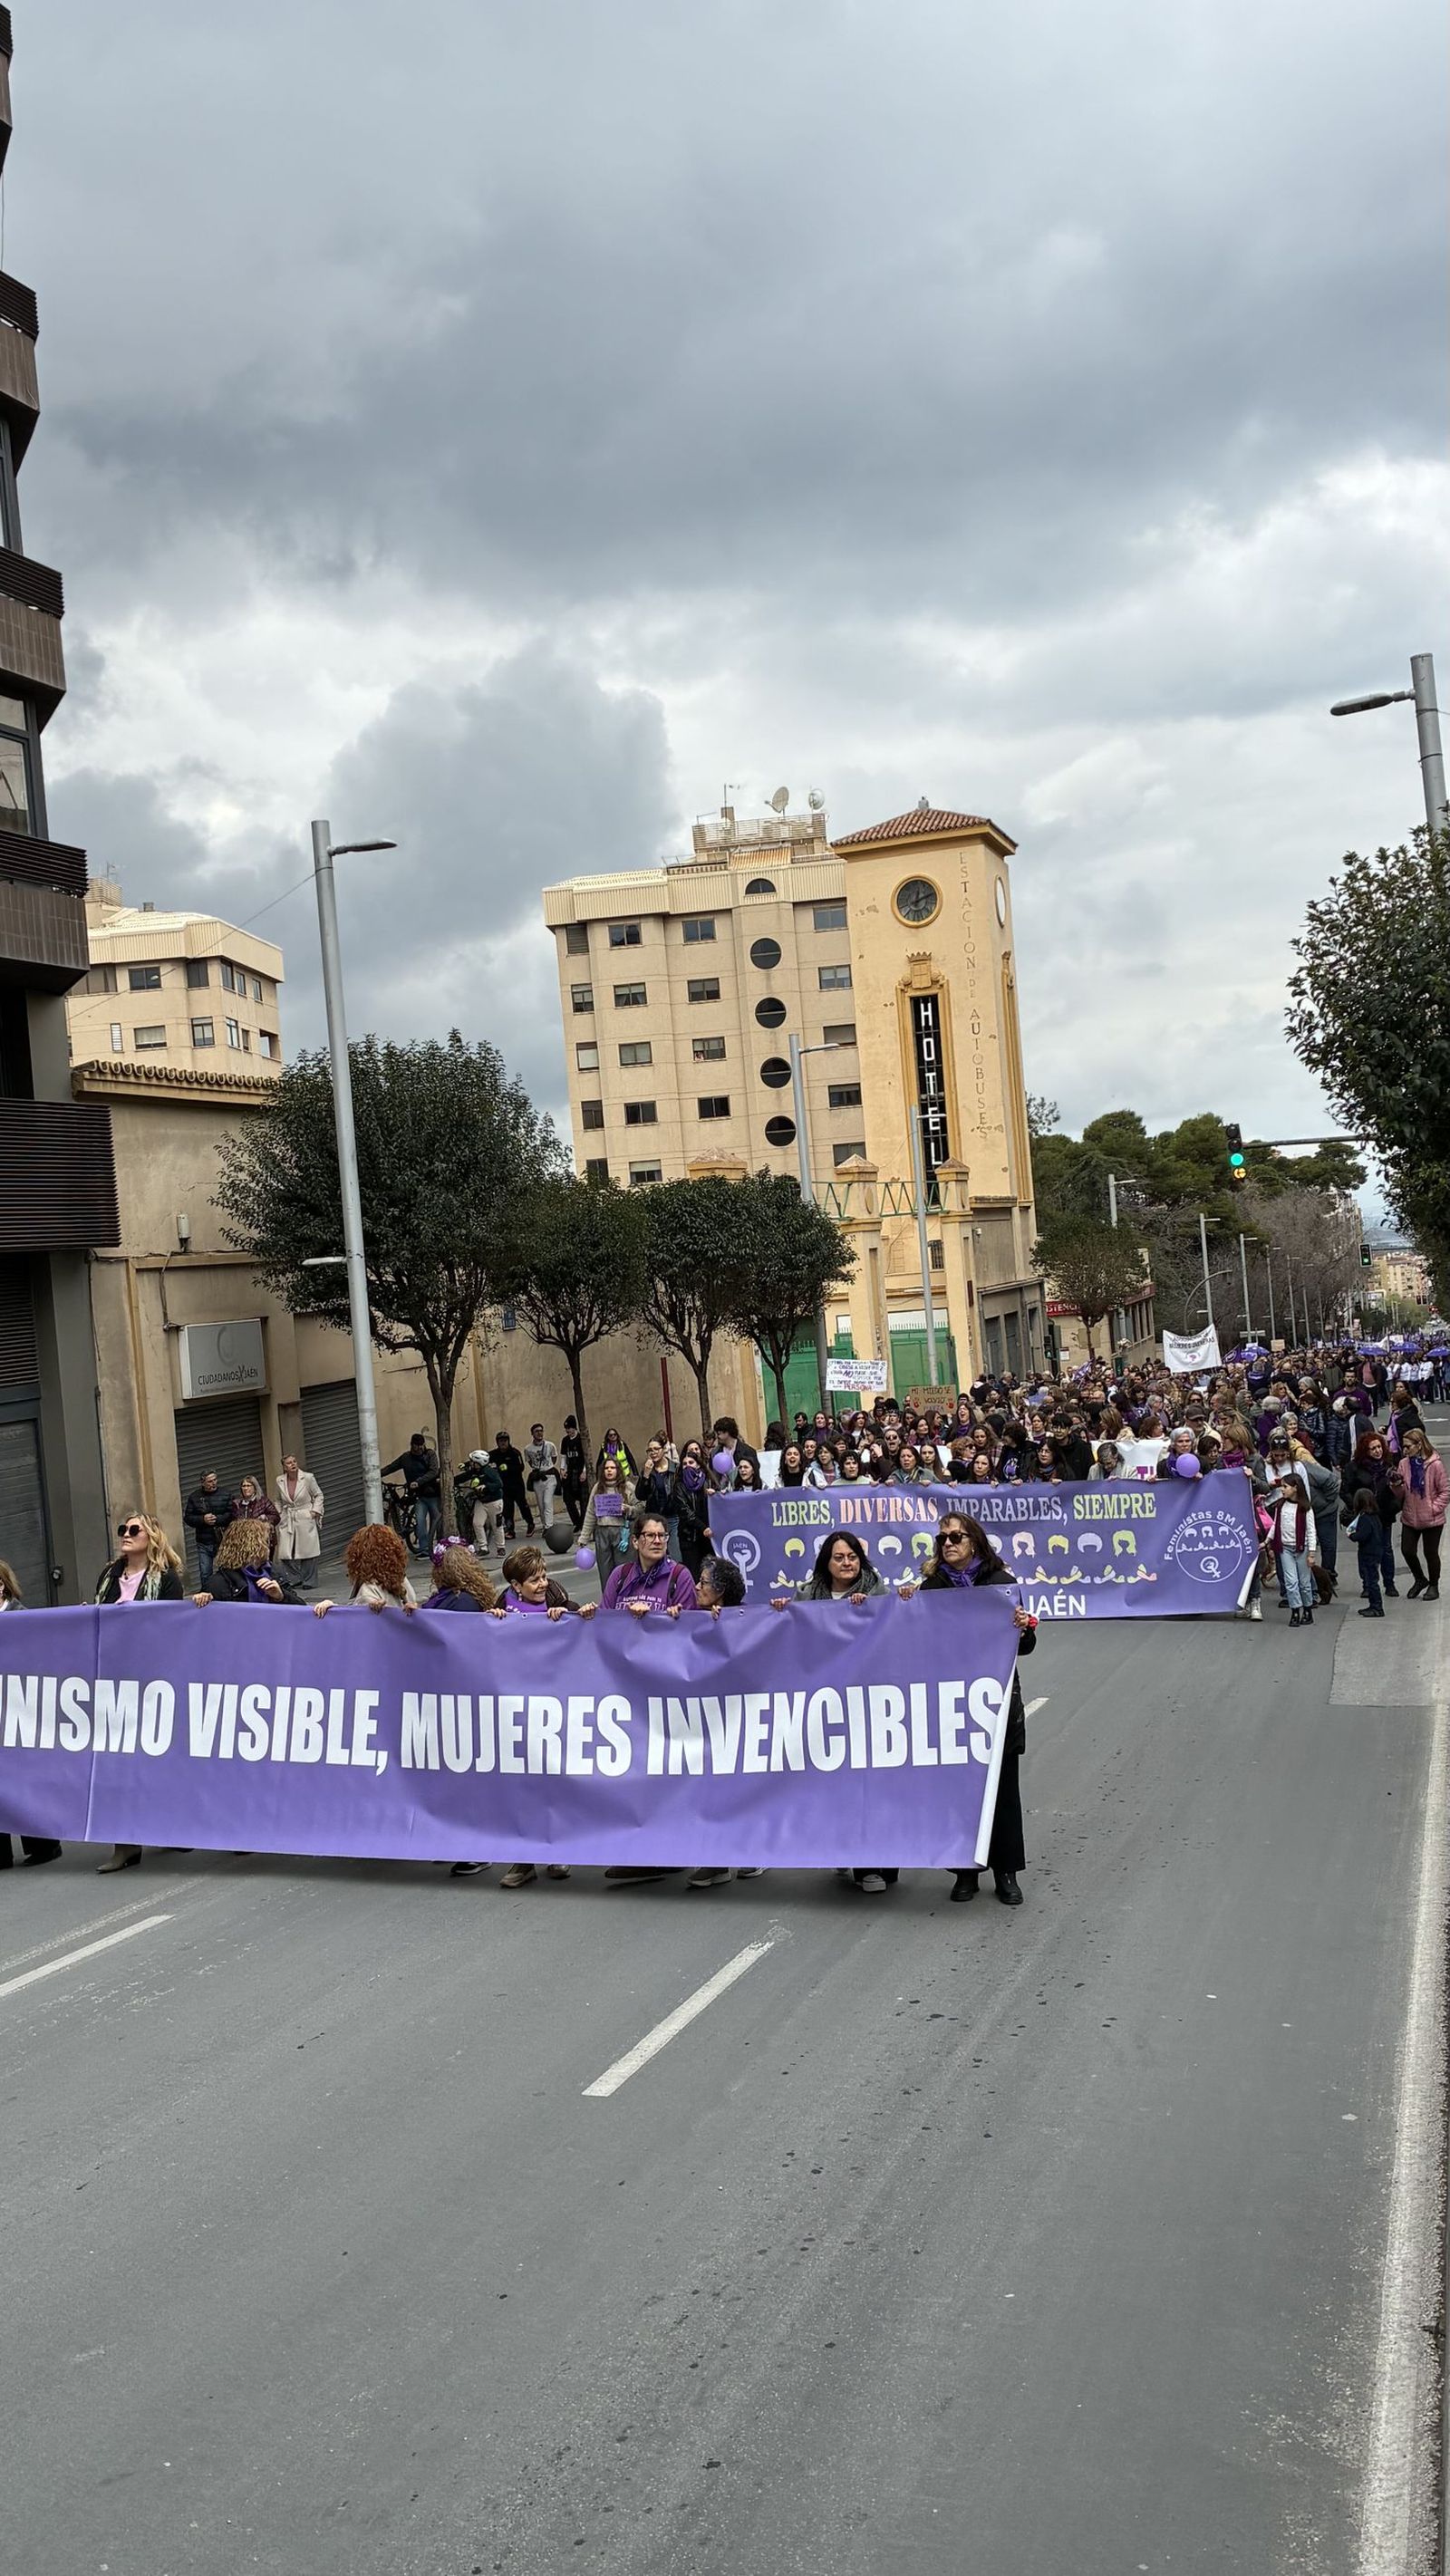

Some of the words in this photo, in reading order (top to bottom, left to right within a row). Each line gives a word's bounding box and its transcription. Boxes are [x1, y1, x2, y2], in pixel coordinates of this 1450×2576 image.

[920, 1002, 943, 1165] HOTEL
[970, 1008, 988, 1140] AUTOBUSES
[771, 1500, 835, 1528] LIBRES,
[946, 1496, 1068, 1526] IMPARABLES,
[1073, 1493, 1156, 1520] SIEMPRE
[1165, 1510, 1213, 1560] Feministas
[1217, 1510, 1236, 1525] 8M
[1234, 1524, 1252, 1554] Jaén
[1024, 1588, 1086, 1616] JAÉN
[0, 1674, 176, 1756] NISMO
[188, 1683, 389, 1776] VISIBLE,
[401, 1692, 632, 1777] MUJERES
[646, 1676, 1005, 1776] INVENCIBLES
